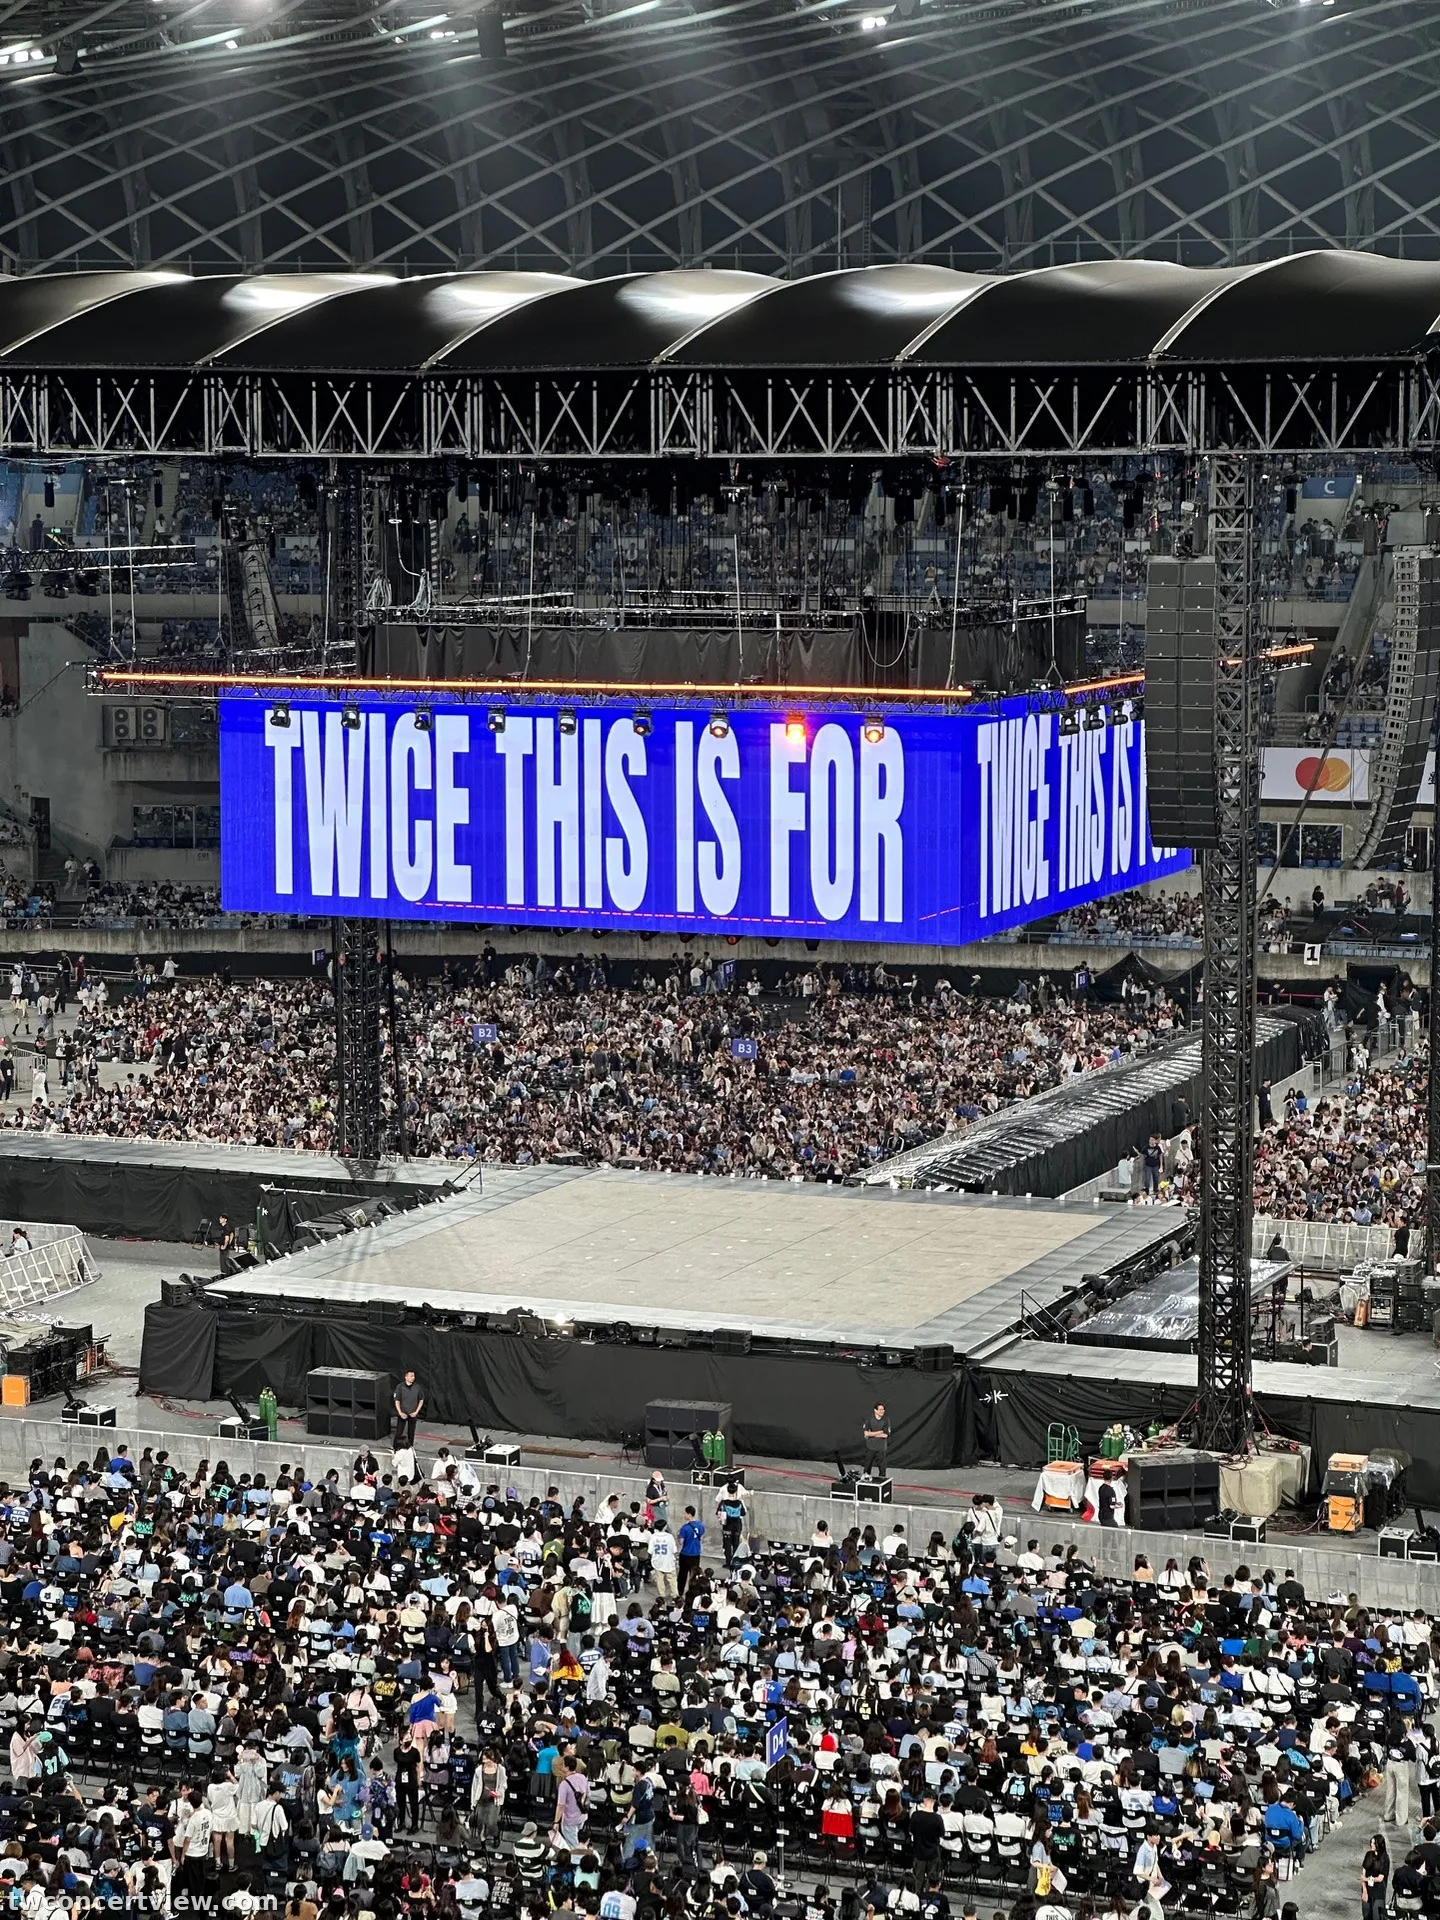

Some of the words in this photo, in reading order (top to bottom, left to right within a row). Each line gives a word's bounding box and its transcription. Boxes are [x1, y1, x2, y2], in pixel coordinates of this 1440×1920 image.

[1324, 481, 1335, 494] C
[978, 713, 1051, 918] TWICE
[1058, 704, 1106, 894] THIS
[1111, 700, 1134, 875] IS
[264, 709, 473, 904] TWICE
[495, 715, 648, 912] THIS
[675, 719, 741, 917] IS
[770, 721, 905, 924] FOR
[1306, 946, 1318, 961] 1
[478, 1028, 492, 1038] B2
[738, 1043, 752, 1054] B3
[654, 1544, 668, 1555] 25
[773, 1729, 783, 1755] D4
